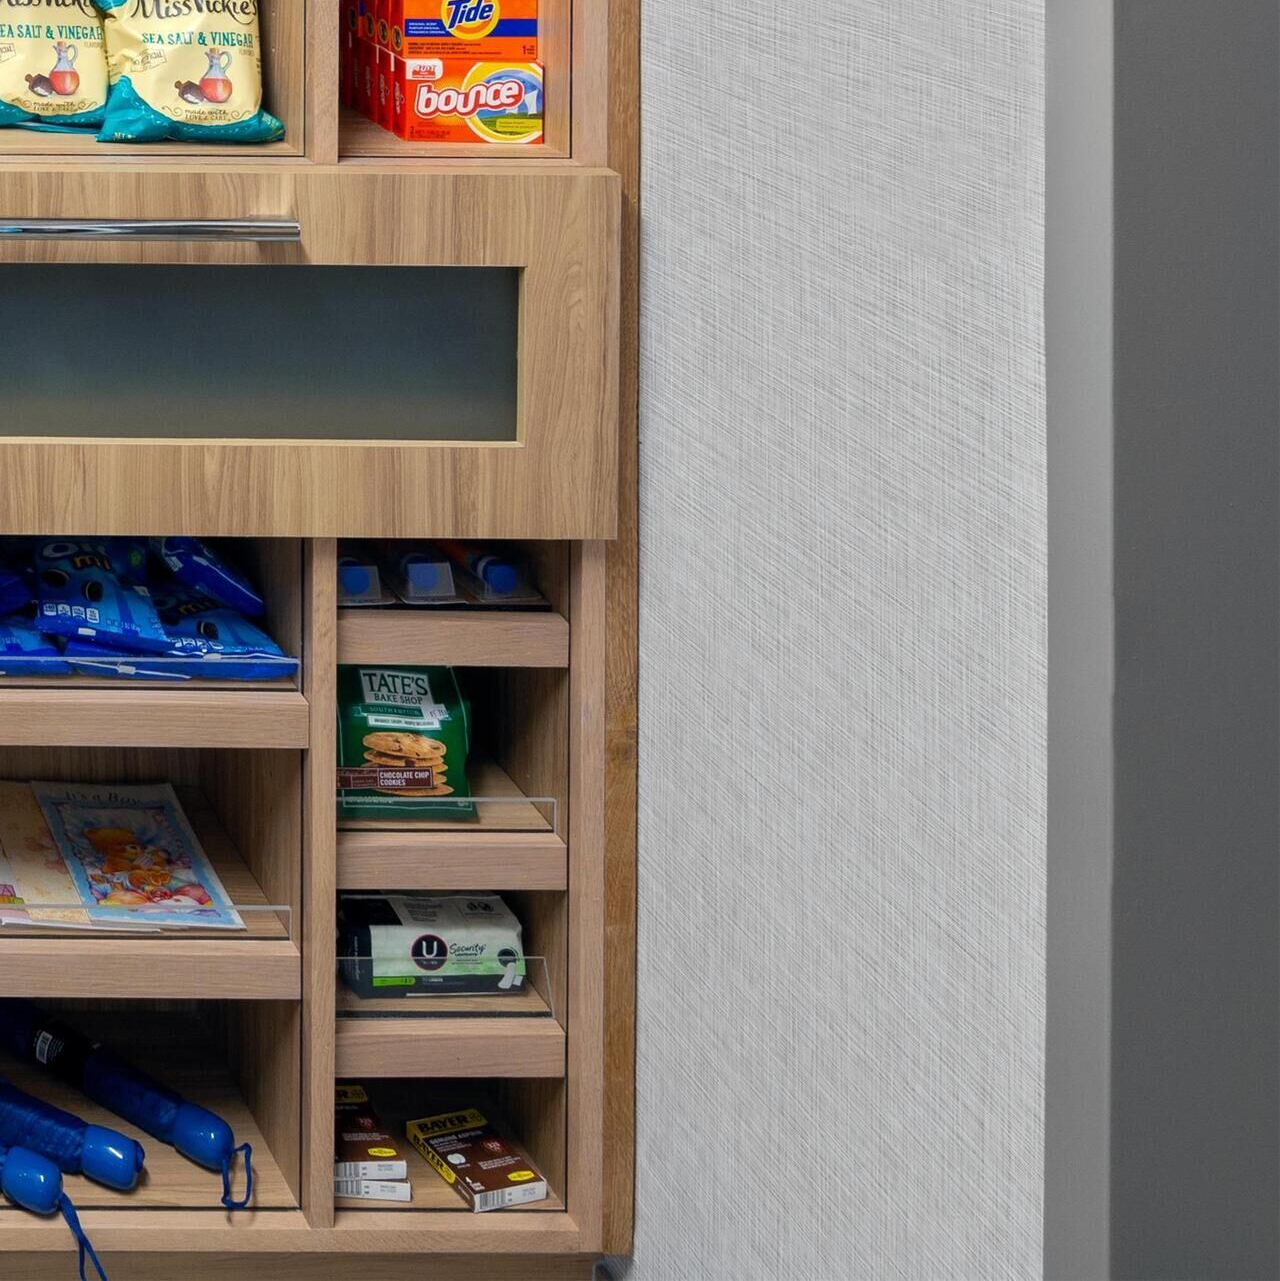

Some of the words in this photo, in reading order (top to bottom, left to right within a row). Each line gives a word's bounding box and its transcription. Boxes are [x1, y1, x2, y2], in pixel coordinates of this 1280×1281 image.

[17, 25, 42, 38] SALT
[58, 25, 103, 40] VINEGAR
[417, 81, 521, 116] bounce
[363, 673, 428, 696] TATE'S
[418, 1115, 469, 1132] BAYER
